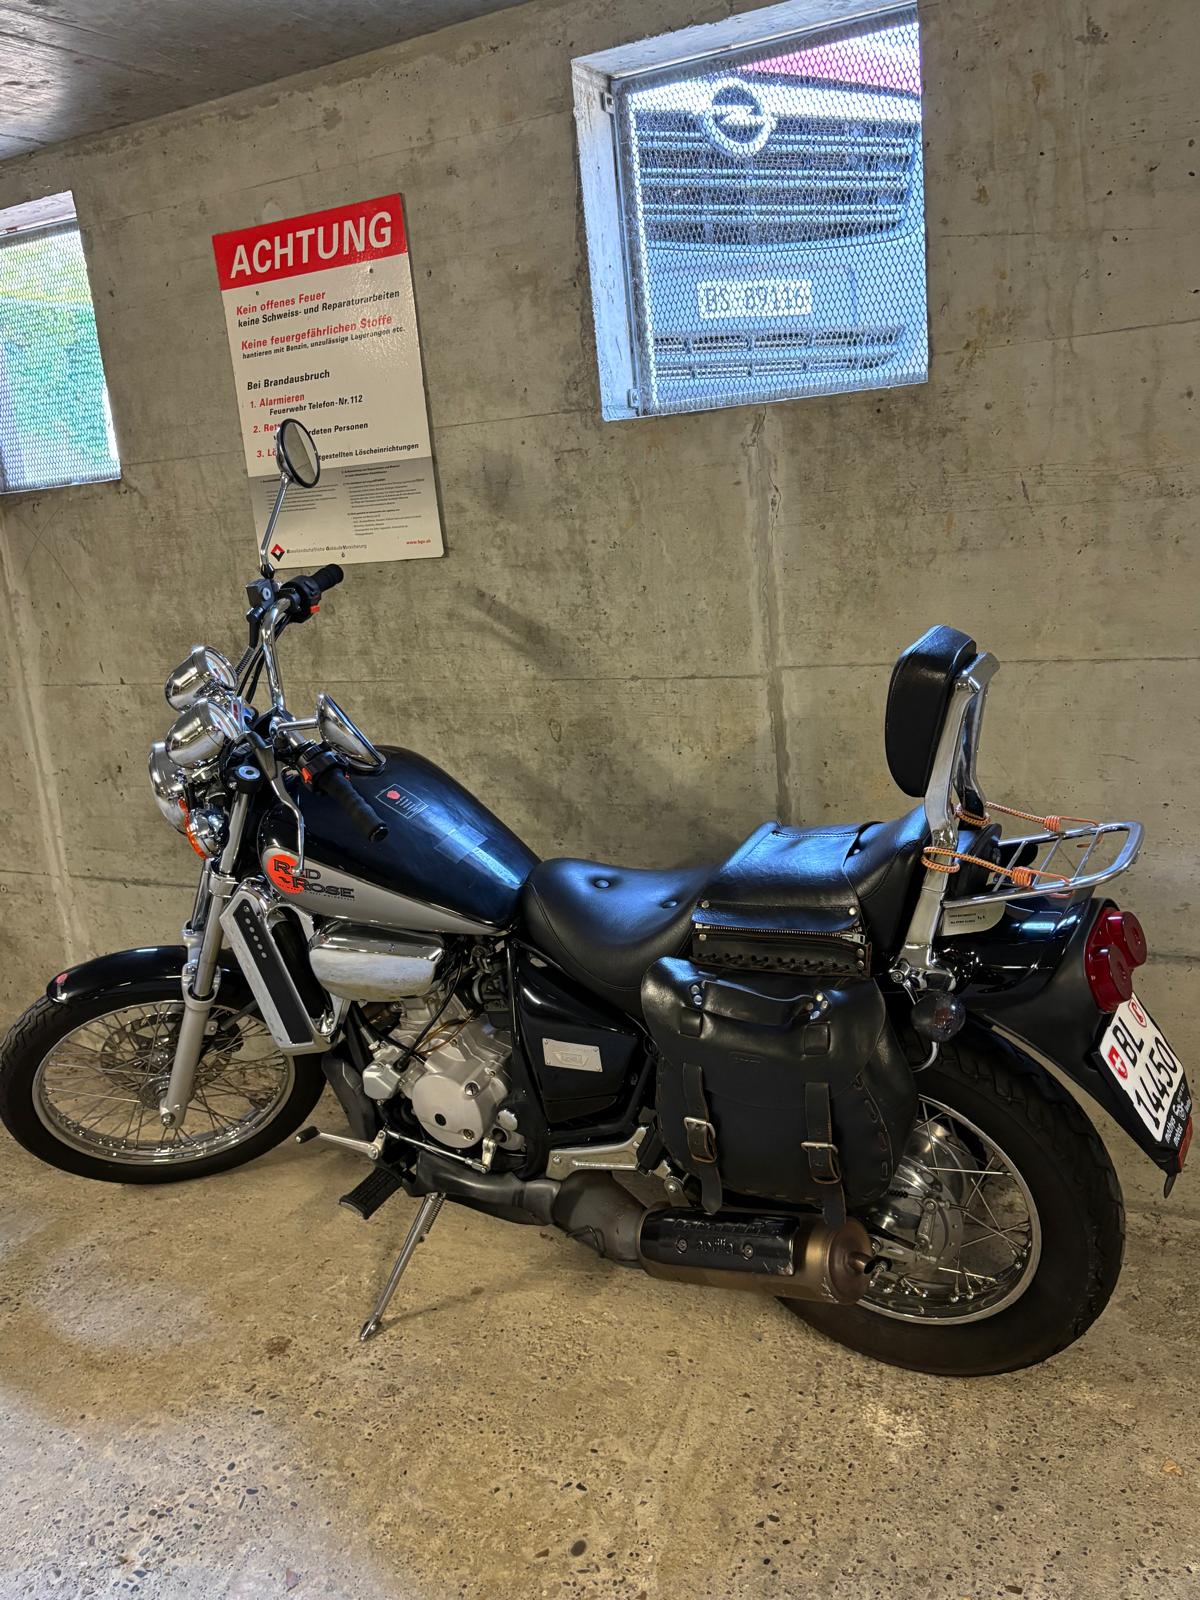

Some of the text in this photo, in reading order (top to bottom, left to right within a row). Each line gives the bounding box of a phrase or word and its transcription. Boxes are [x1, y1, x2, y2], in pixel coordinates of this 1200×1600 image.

[230, 211, 392, 279] ACHTUNG
[236, 290, 326, 316] Kein offenes Feuer
[238, 289, 400, 328] keine Schweiss- und Reparaturarbeiten
[241, 315, 393, 350] Keine feuergefährlichen Stoffe
[242, 348, 273, 360] hantieren
[273, 345, 285, 354] mit
[286, 341, 309, 352] Benzin,
[310, 335, 349, 349] unzulässige
[392, 325, 406, 334] etc.
[247, 369, 330, 391] Bei Brandausbruch
[250, 393, 305, 409] 1. Alarmieren
[269, 404, 307, 416] Feuerwehr
[253, 425, 261, 433] 2.
[334, 422, 369, 433] Personen
[256, 449, 265, 458] 3.
[355, 442, 419, 456] Löscheinrichtungen
[273, 859, 321, 880] RD
[291, 876, 355, 898] ROSE
[1112, 1016, 1145, 1068] BL
[1135, 1036, 1178, 1130] 14450
